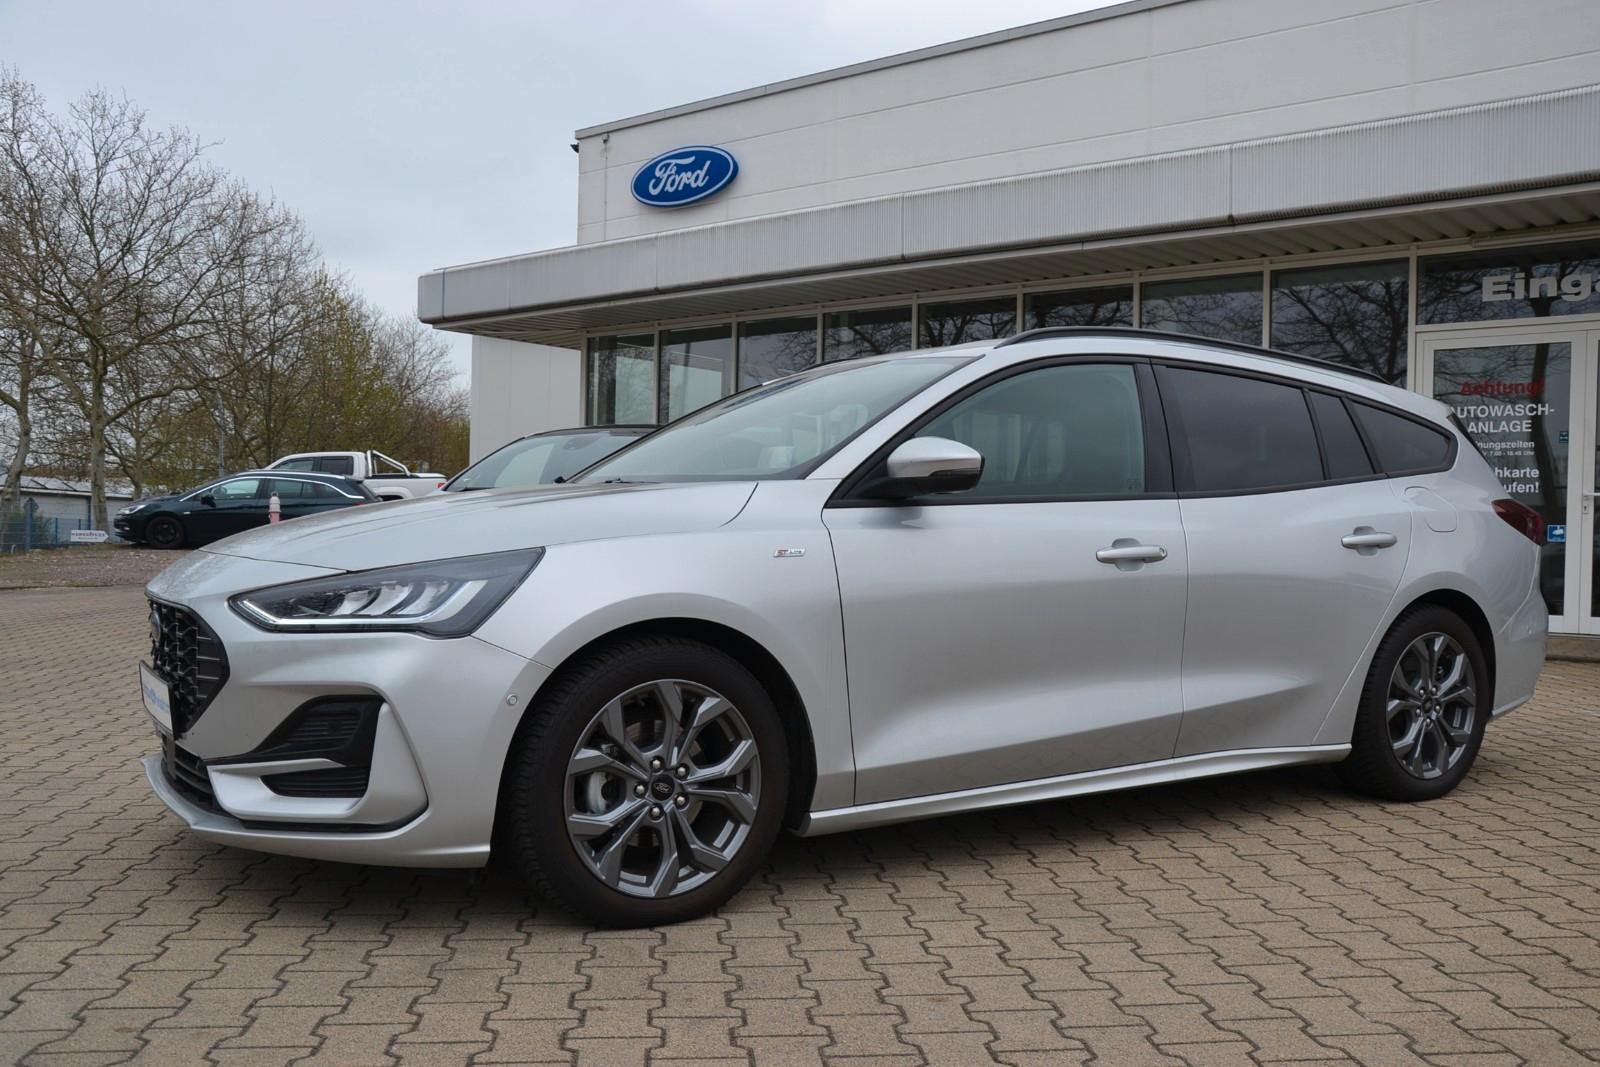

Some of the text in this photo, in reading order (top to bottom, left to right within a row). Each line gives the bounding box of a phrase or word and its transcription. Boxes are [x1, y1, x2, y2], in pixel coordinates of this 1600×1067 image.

[648, 155, 711, 196] Ford
[1467, 420, 1532, 433] ANLAGE
[1475, 440, 1535, 450] nungszeiten
